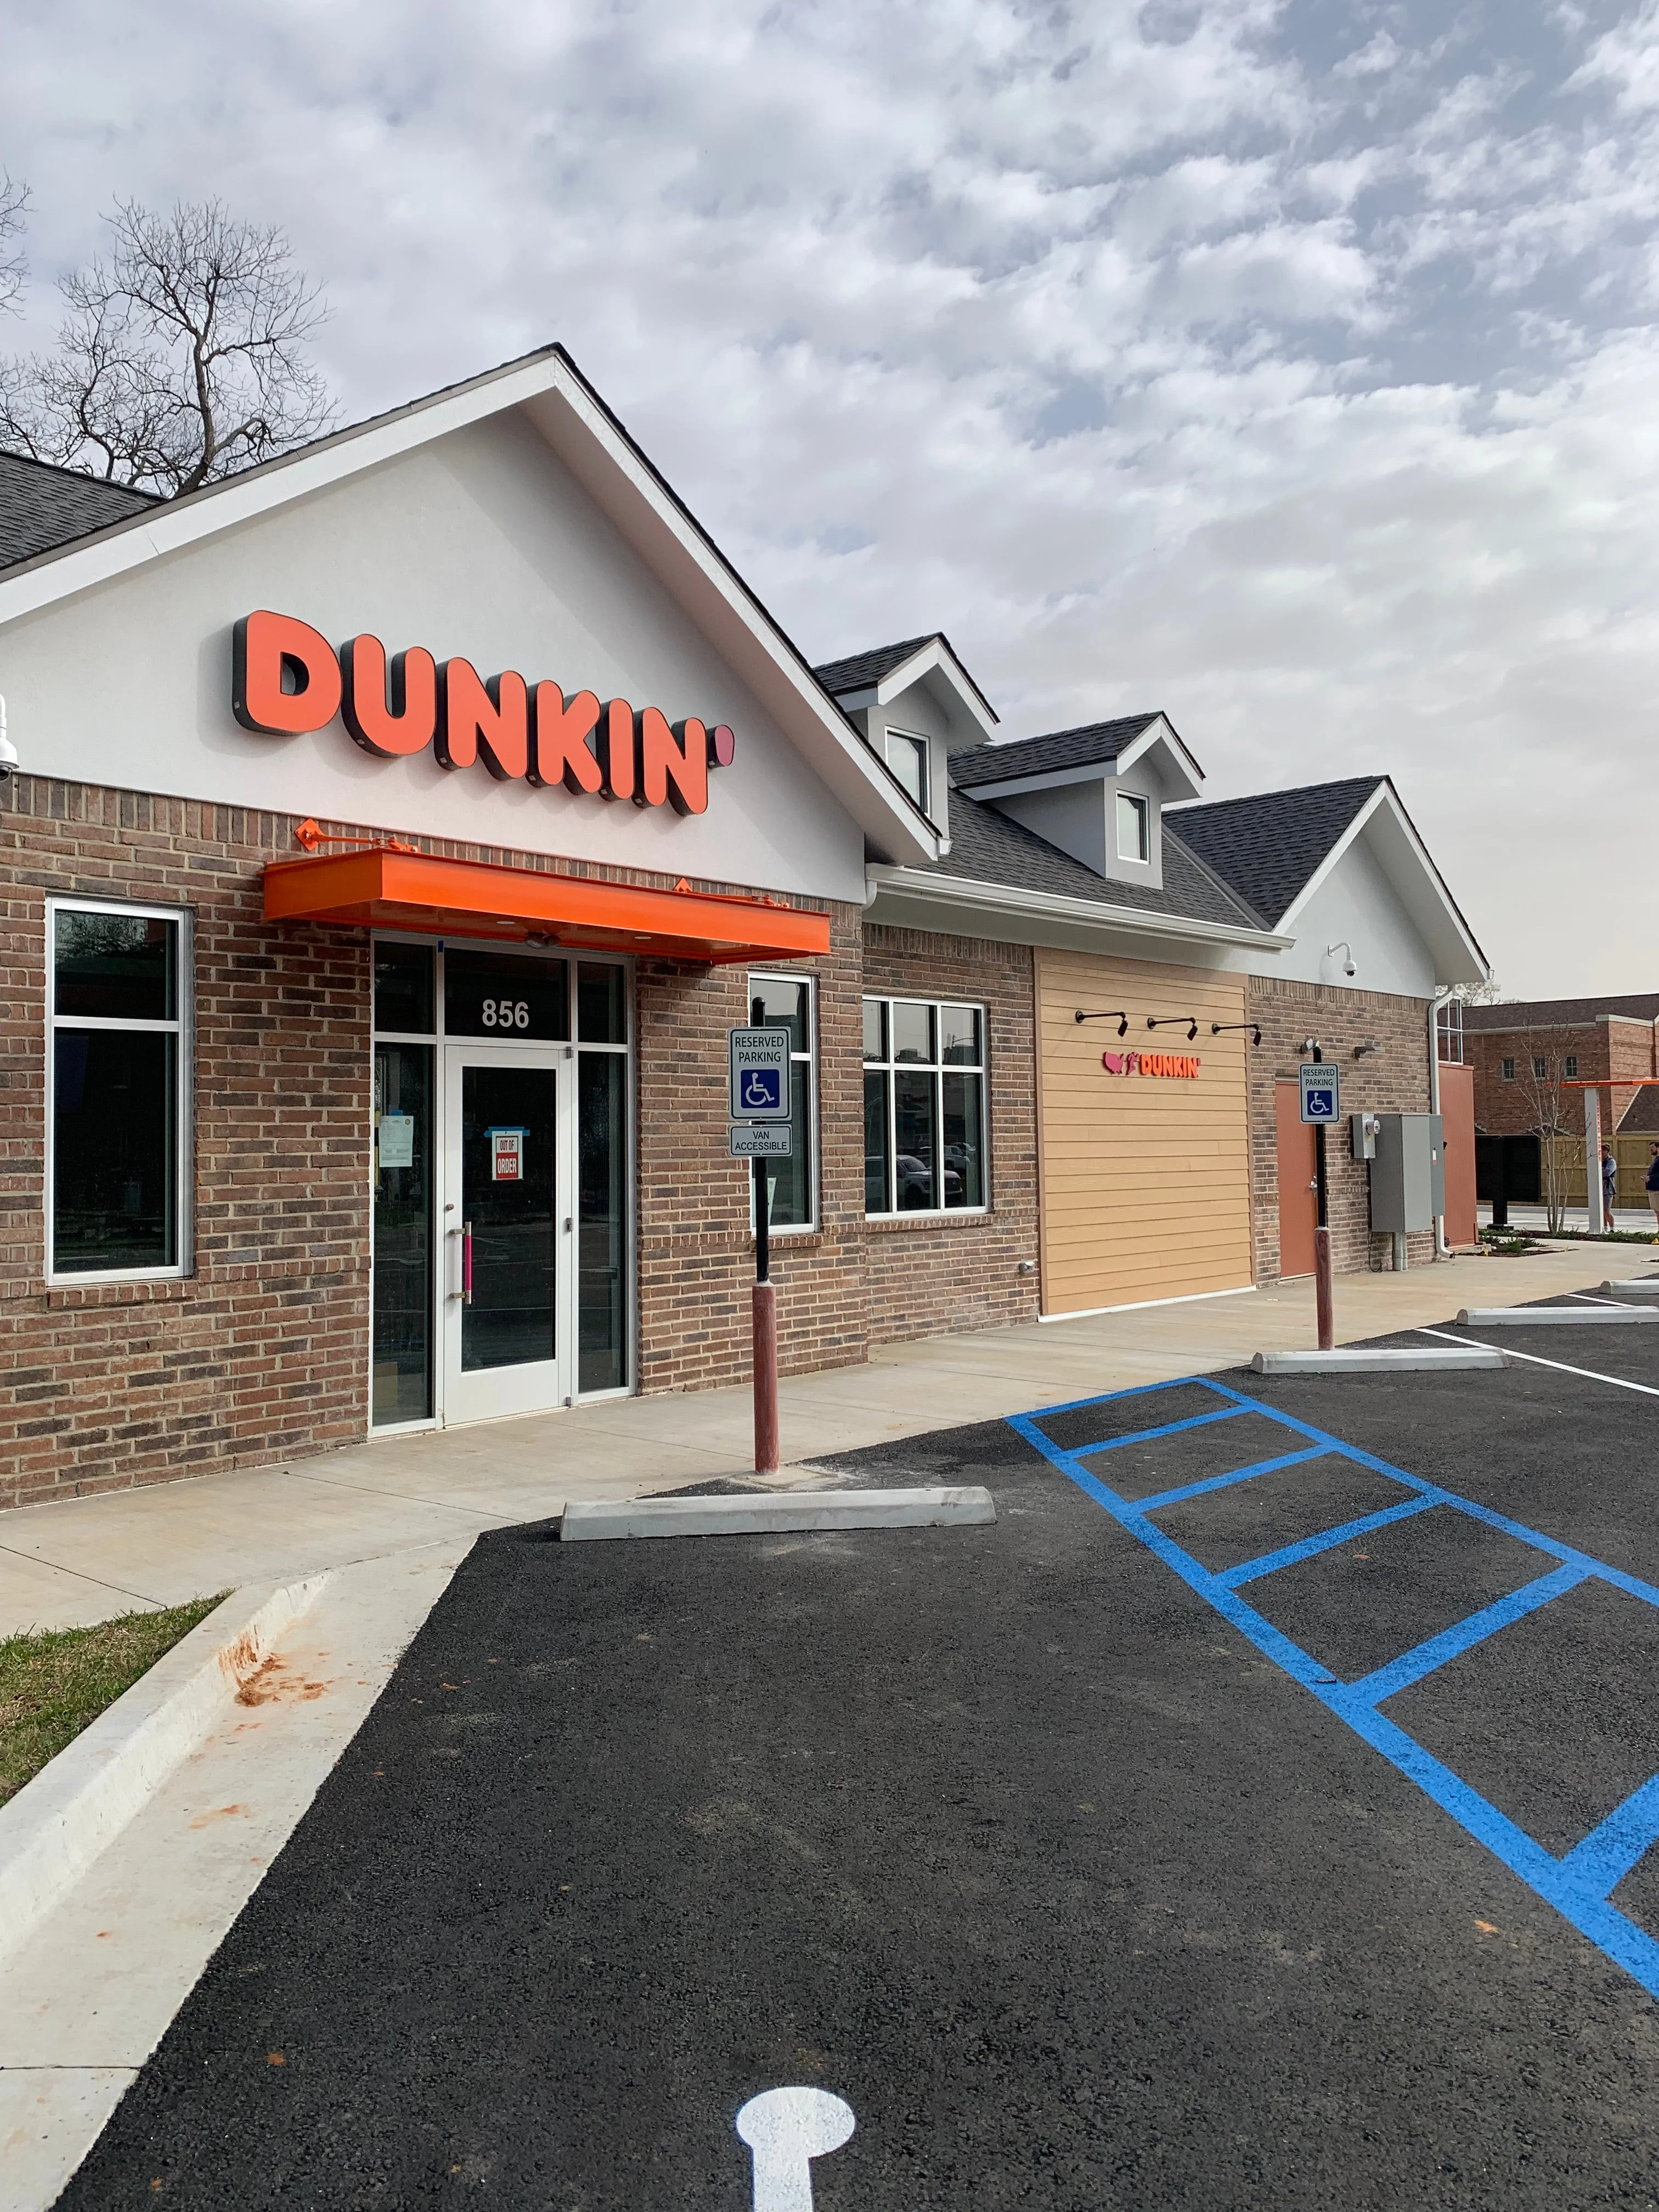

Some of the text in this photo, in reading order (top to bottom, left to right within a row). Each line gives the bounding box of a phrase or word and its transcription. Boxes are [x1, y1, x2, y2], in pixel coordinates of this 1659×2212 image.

[233, 610, 735, 815] DUNKIN'
[482, 999, 529, 1028] 856
[735, 1036, 784, 1047] RESERVED
[738, 1052, 781, 1062] PARKING
[509, 1140, 514, 1150] OF
[735, 1142, 787, 1150] ACCESSIBLE
[498, 1158, 517, 1174] ORDER
